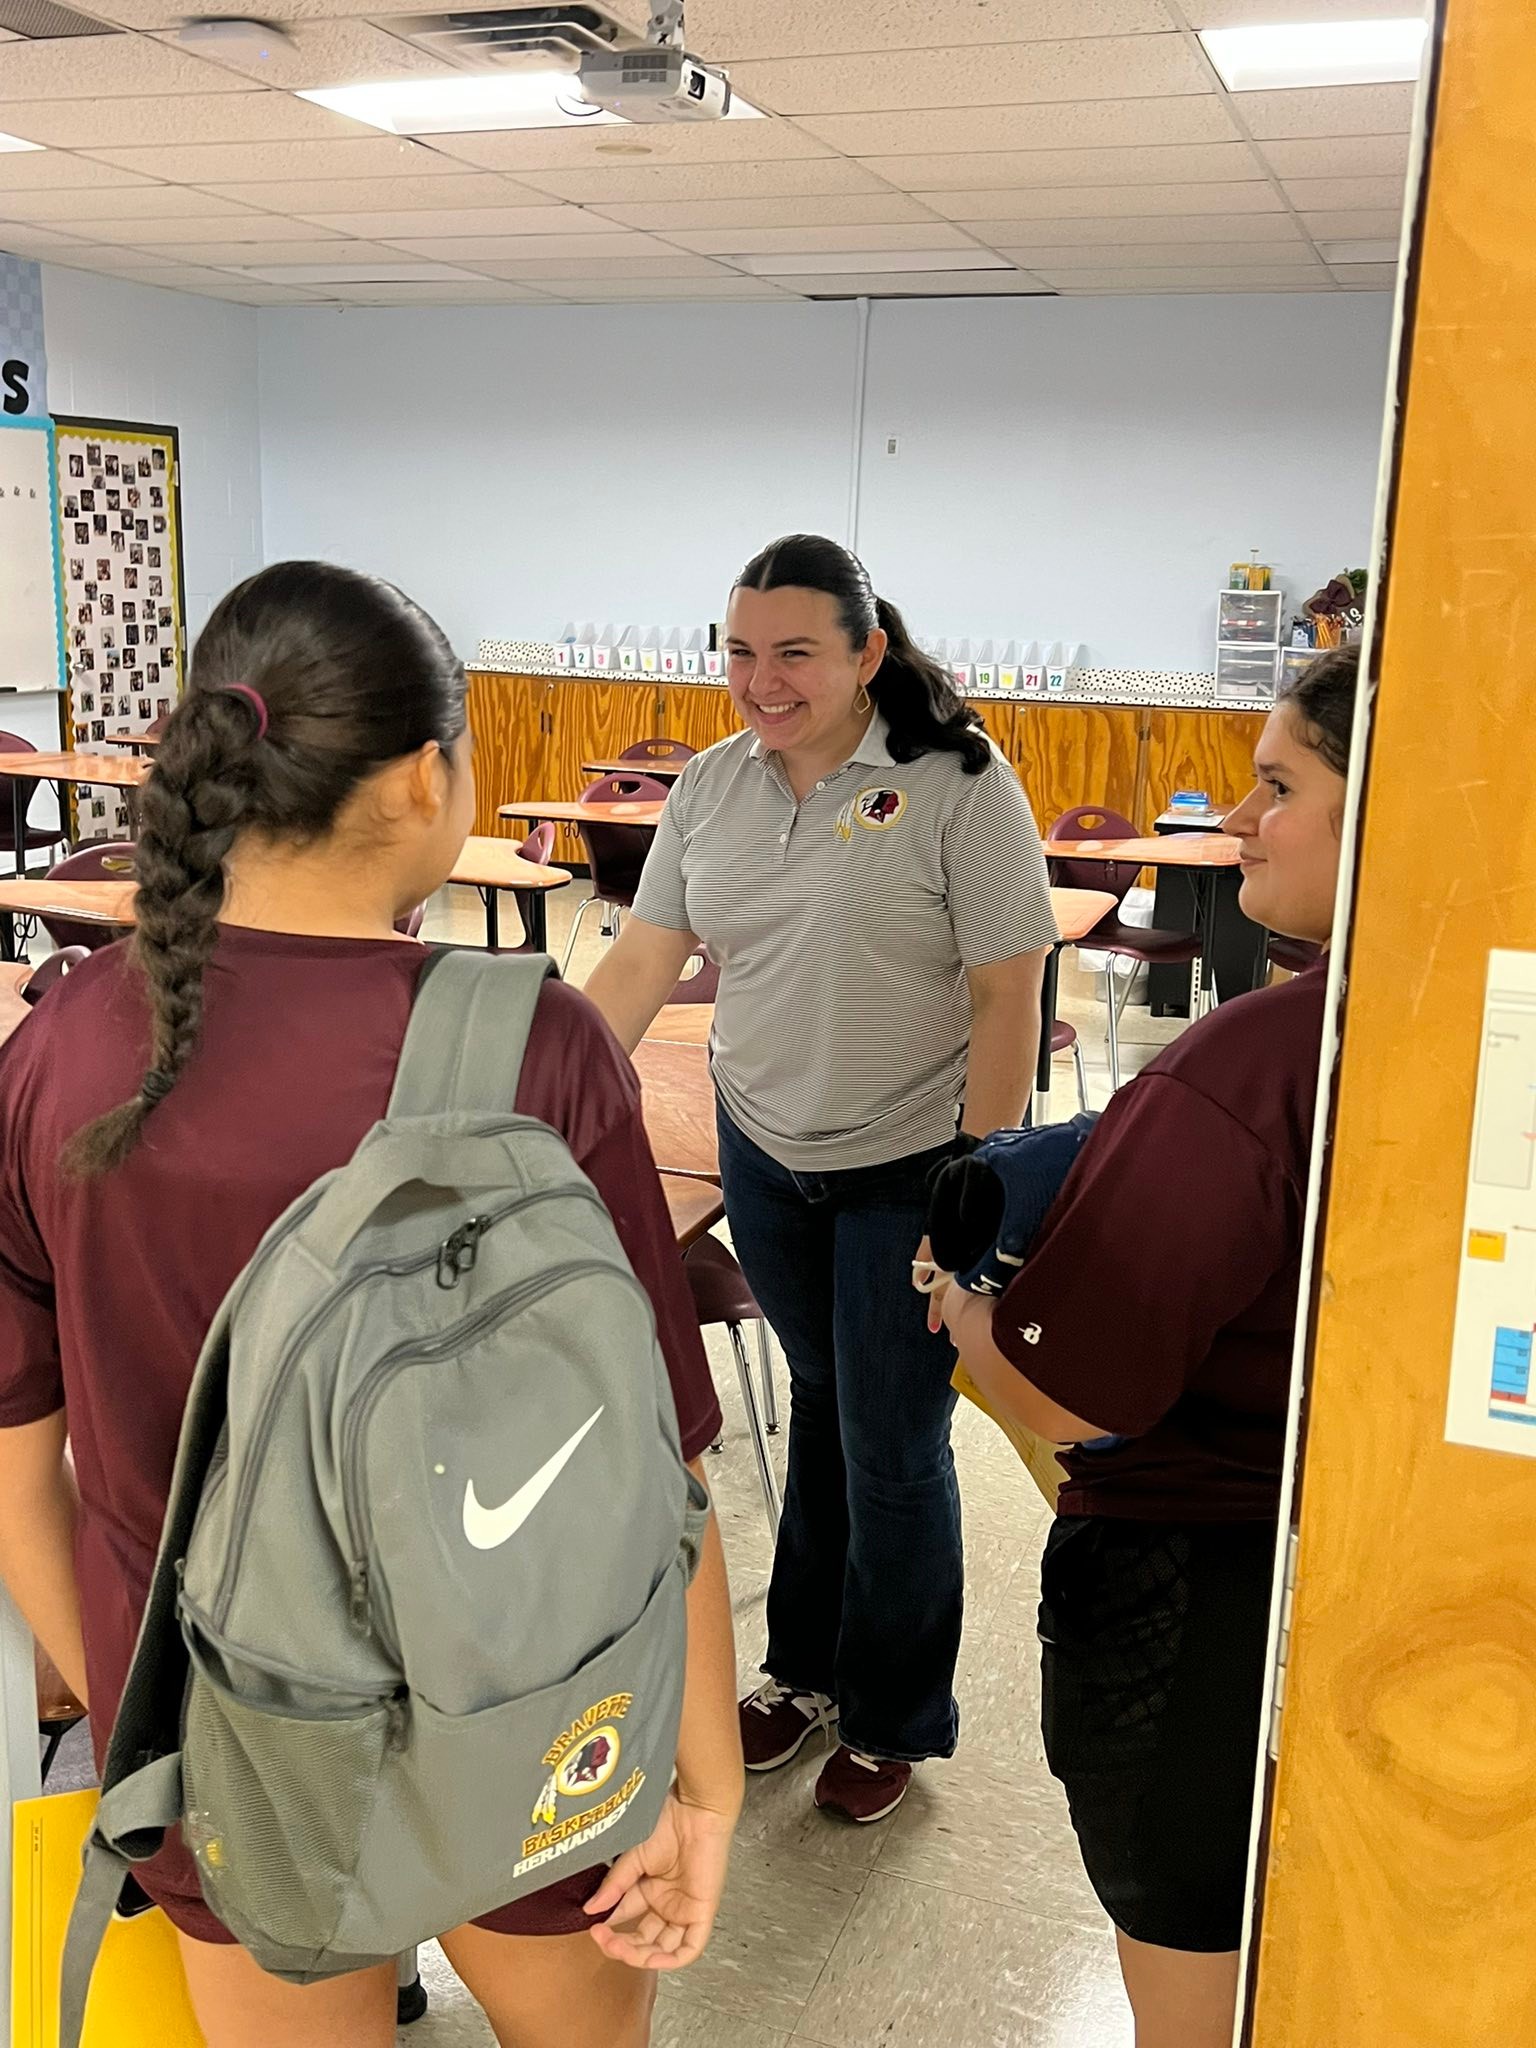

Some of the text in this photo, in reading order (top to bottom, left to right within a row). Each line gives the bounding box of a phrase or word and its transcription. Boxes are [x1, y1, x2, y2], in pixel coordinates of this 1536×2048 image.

[558, 651, 564, 664] 1
[577, 651, 585, 664] 2
[597, 653, 605, 666] 3
[623, 654, 631, 667] 4
[665, 657, 673, 670] 6
[686, 659, 693, 672] 7
[709, 660, 716, 672] 8
[978, 672, 990, 685] 19
[1025, 674, 1038, 686] 21
[1049, 674, 1062, 687] 22
[521, 1766, 645, 1858] BASKETBALL
